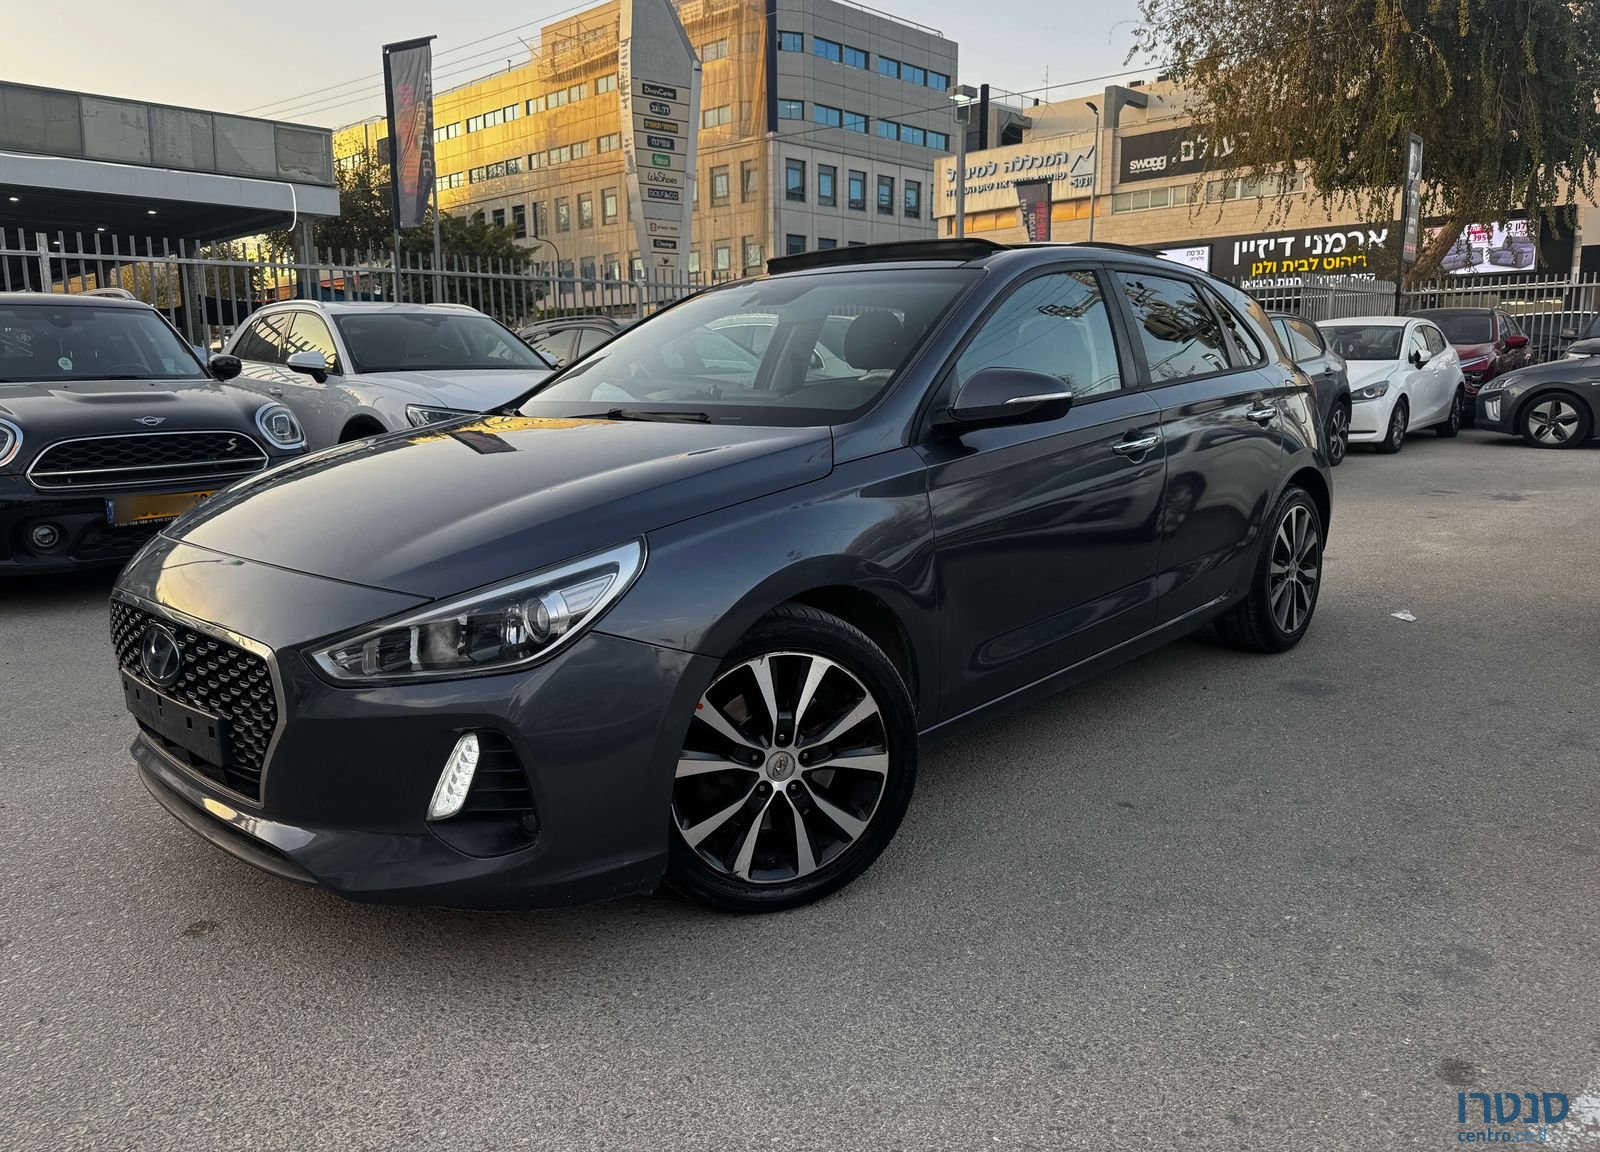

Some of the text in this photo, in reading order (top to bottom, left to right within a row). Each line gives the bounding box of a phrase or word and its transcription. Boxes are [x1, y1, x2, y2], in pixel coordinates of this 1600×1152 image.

[946, 161, 997, 182] למינל
[1004, 151, 1067, 174] המכללה
[1129, 155, 1167, 172] swagg
[647, 171, 678, 184] WeShoes
[649, 190, 678, 200] GOLF&CO
[1233, 228, 1388, 266] ארמני דיזיין
[1251, 255, 1367, 276] ריהוט לבית ולגן
[1276, 276, 1302, 287] חנות
